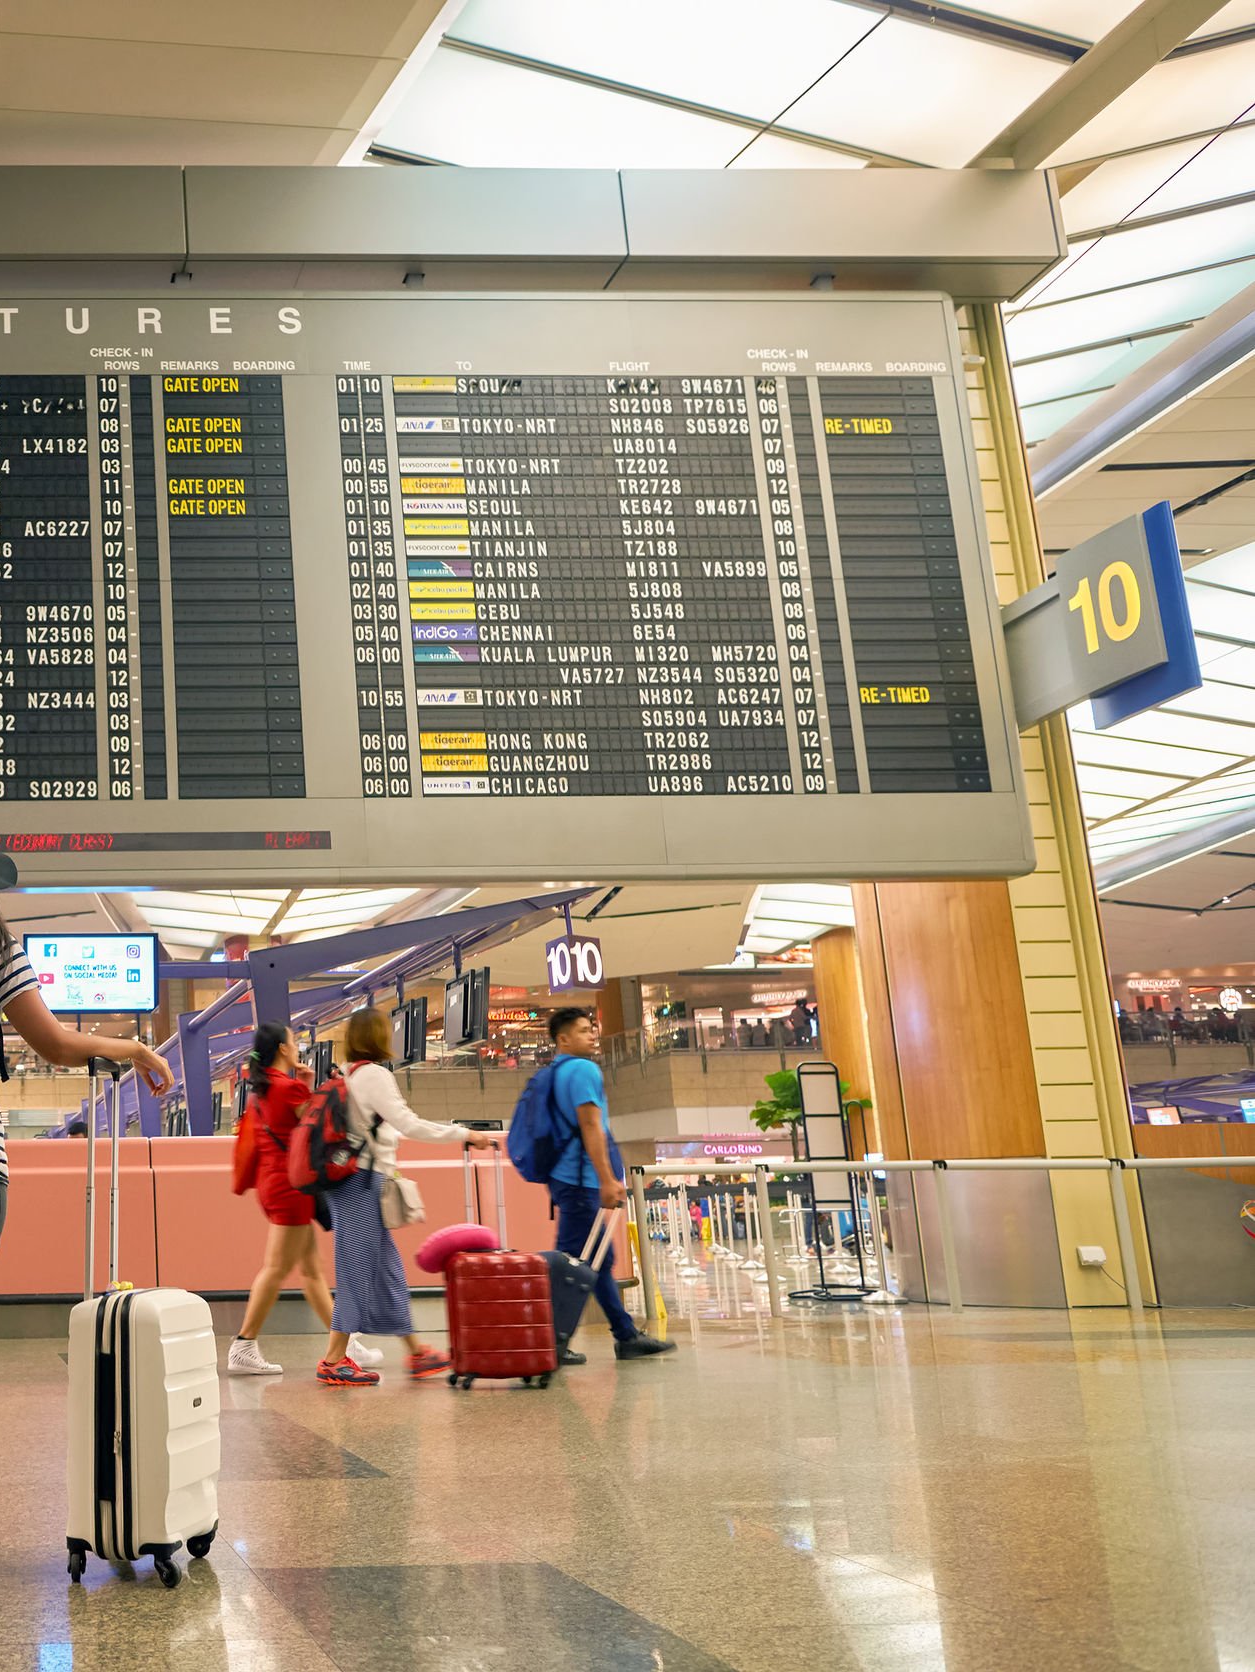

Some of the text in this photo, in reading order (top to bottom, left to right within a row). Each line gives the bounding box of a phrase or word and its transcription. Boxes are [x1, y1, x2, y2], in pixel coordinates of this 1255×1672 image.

[104, 360, 140, 371] ROWS
[160, 360, 220, 371] REMARKS
[233, 360, 296, 371] BOARDING
[342, 360, 371, 371] TIME
[455, 360, 473, 371] TO
[609, 361, 650, 372] FLIGHT
[761, 362, 797, 372] ROWS
[815, 362, 873, 372] REMARKS
[885, 362, 947, 372] BOARDING
[164, 377, 239, 393] GATE OPEN
[683, 398, 747, 414] TP7615
[460, 418, 556, 434] TOKYO-NRT
[610, 418, 664, 434] NH846
[824, 418, 893, 434] RE-TIMED
[22, 438, 87, 454] LX4182
[612, 438, 677, 454] UA8014
[466, 479, 531, 495] MANILA
[617, 478, 682, 495] TR2728
[468, 499, 522, 516] SEOUL
[24, 520, 90, 537] AC6227
[471, 540, 548, 557] TIANJIN
[623, 540, 678, 557] TZ188
[473, 561, 539, 578] CAIRNS
[701, 560, 767, 578] VA5899
[26, 605, 93, 622] 9W4670
[477, 603, 521, 620] CEBU
[1068, 561, 1141, 655] 10
[415, 626, 458, 639] IndiGo
[479, 625, 553, 642] CHENNAI
[632, 624, 676, 641] 6E54
[26, 648, 94, 665] VA5828
[711, 644, 777, 662] MH5720
[636, 666, 702, 684] NZ3544
[27, 692, 95, 709] NZ3444
[859, 687, 930, 704] RE-TIMED
[487, 732, 588, 750] HONG KONG
[489, 754, 590, 773] GUANGZHOU
[645, 753, 712, 771] TR2986
[29, 780, 97, 798] SQ2929
[491, 777, 569, 795] CHICAGO
[727, 774, 792, 793] AC5210
[547, 942, 571, 987] 10
[570, 941, 603, 984] 10
